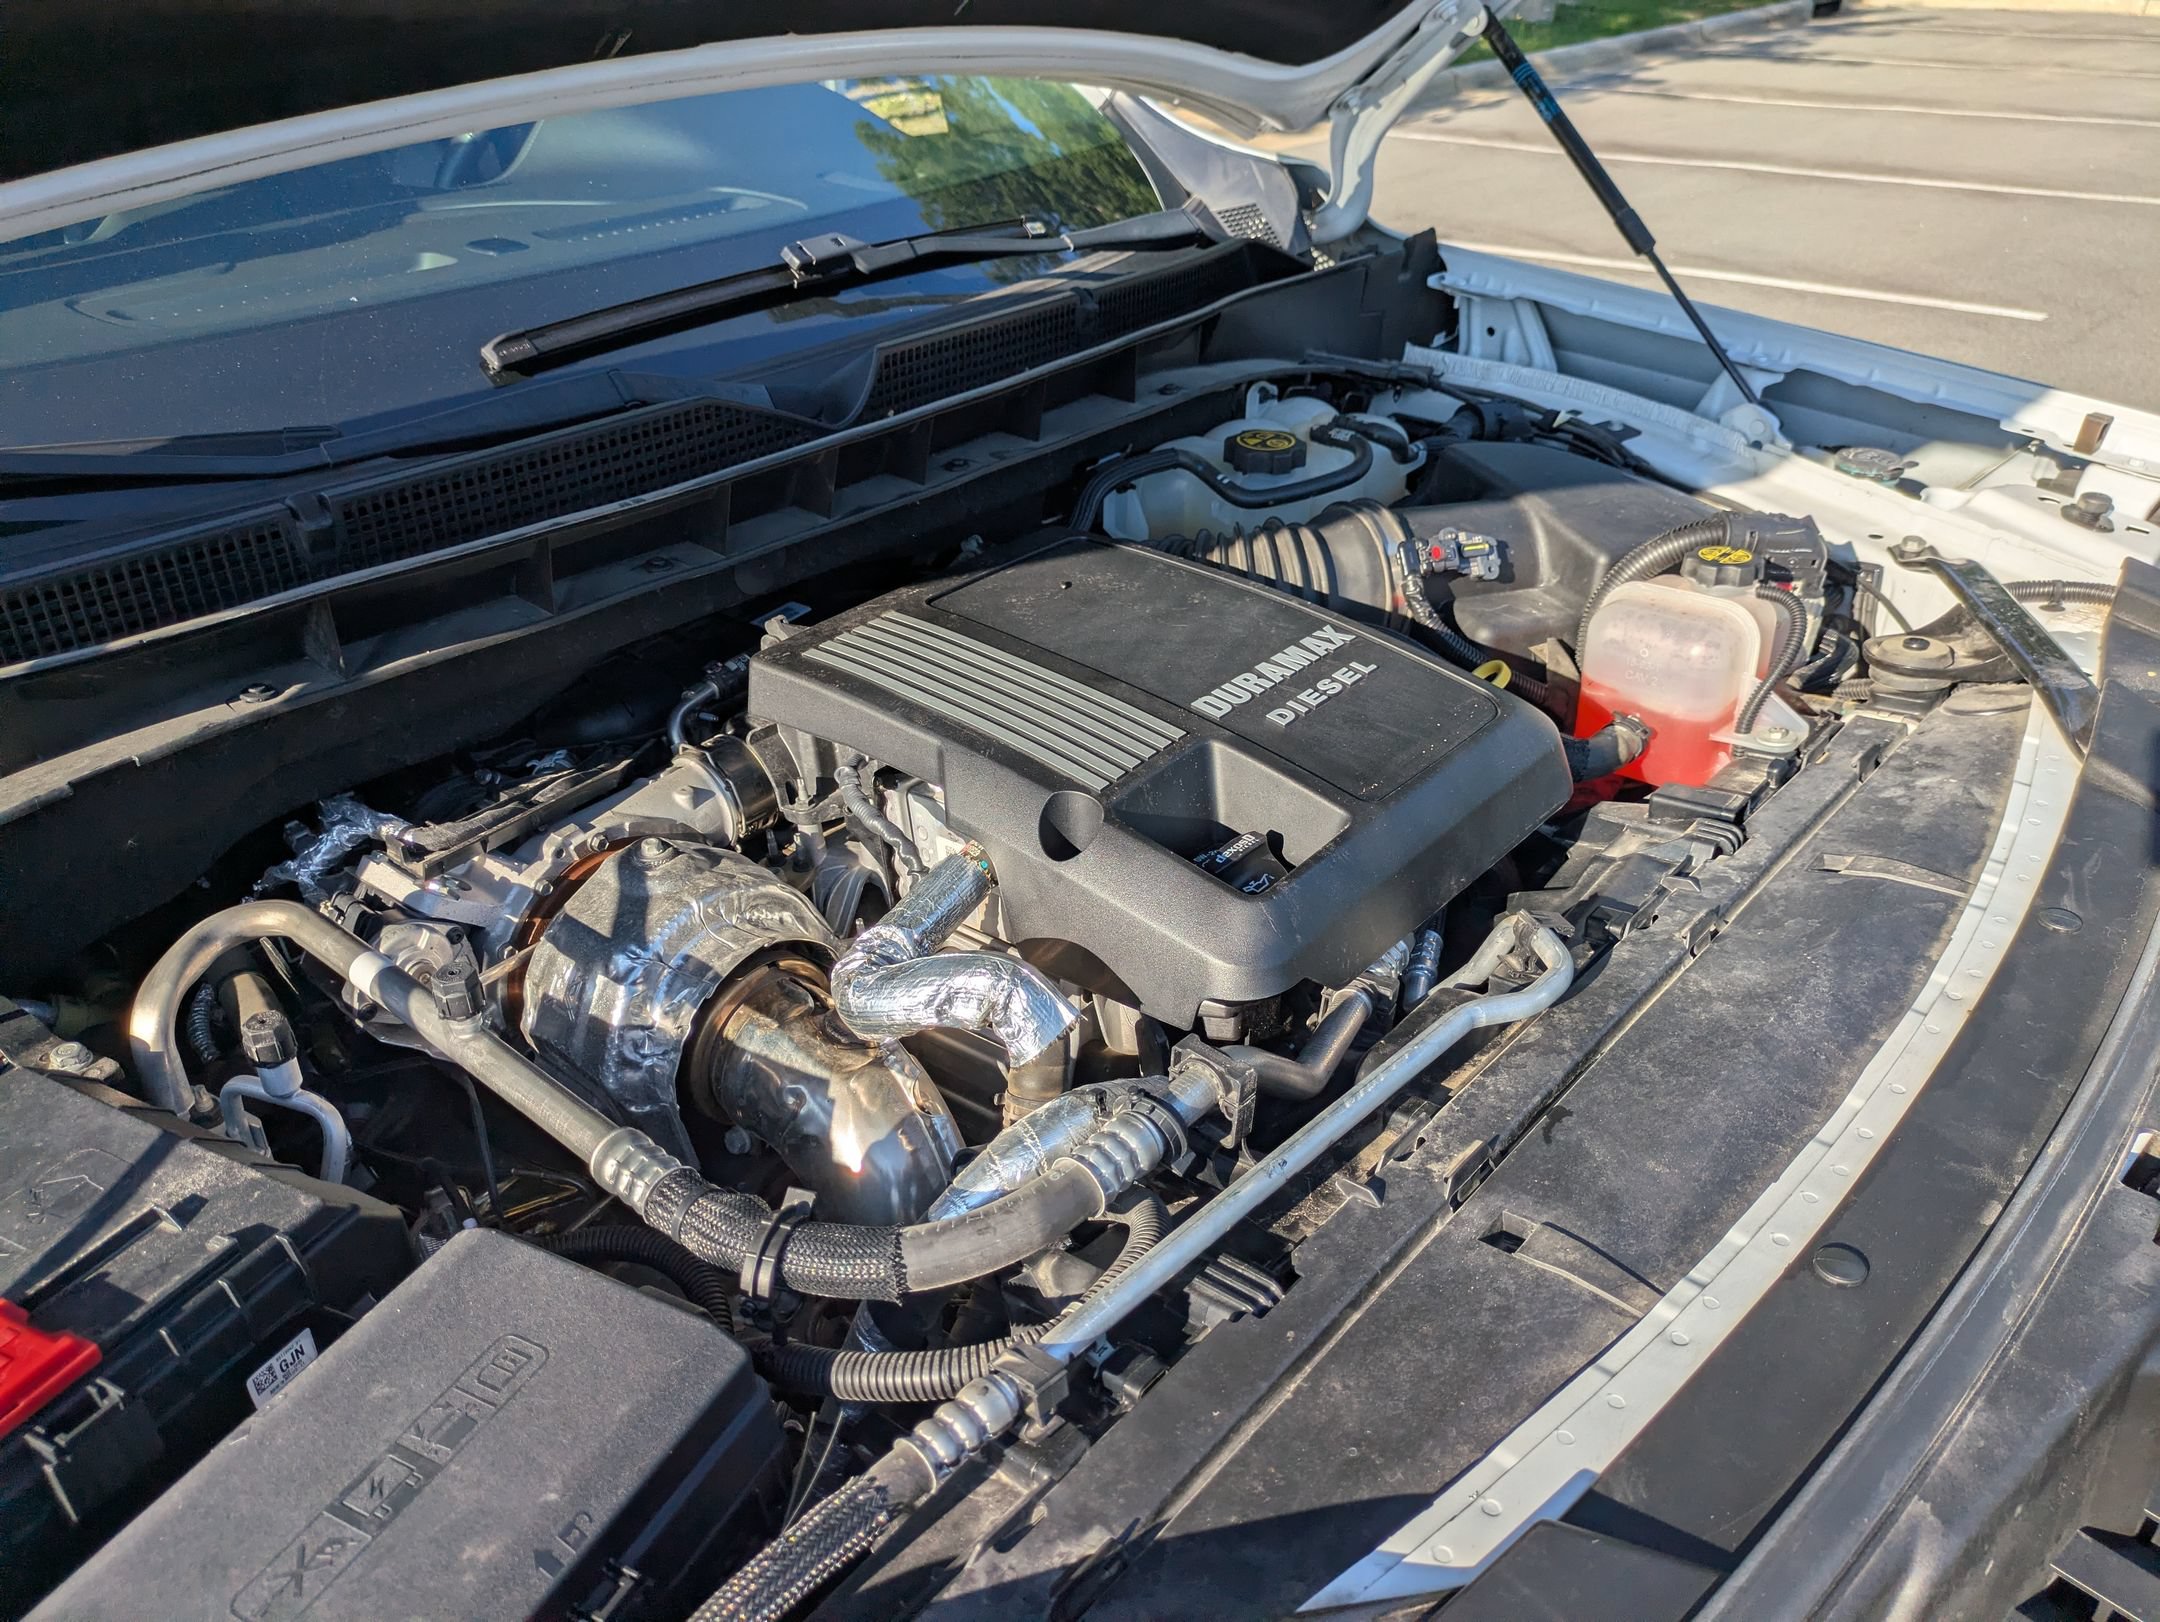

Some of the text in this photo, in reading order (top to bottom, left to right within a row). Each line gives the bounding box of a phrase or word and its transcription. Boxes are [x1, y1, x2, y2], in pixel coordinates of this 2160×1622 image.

[1191, 624, 1357, 720] DURAMAX
[1265, 661, 1379, 728] DIESEL
[279, 1343, 306, 1373] GJN
